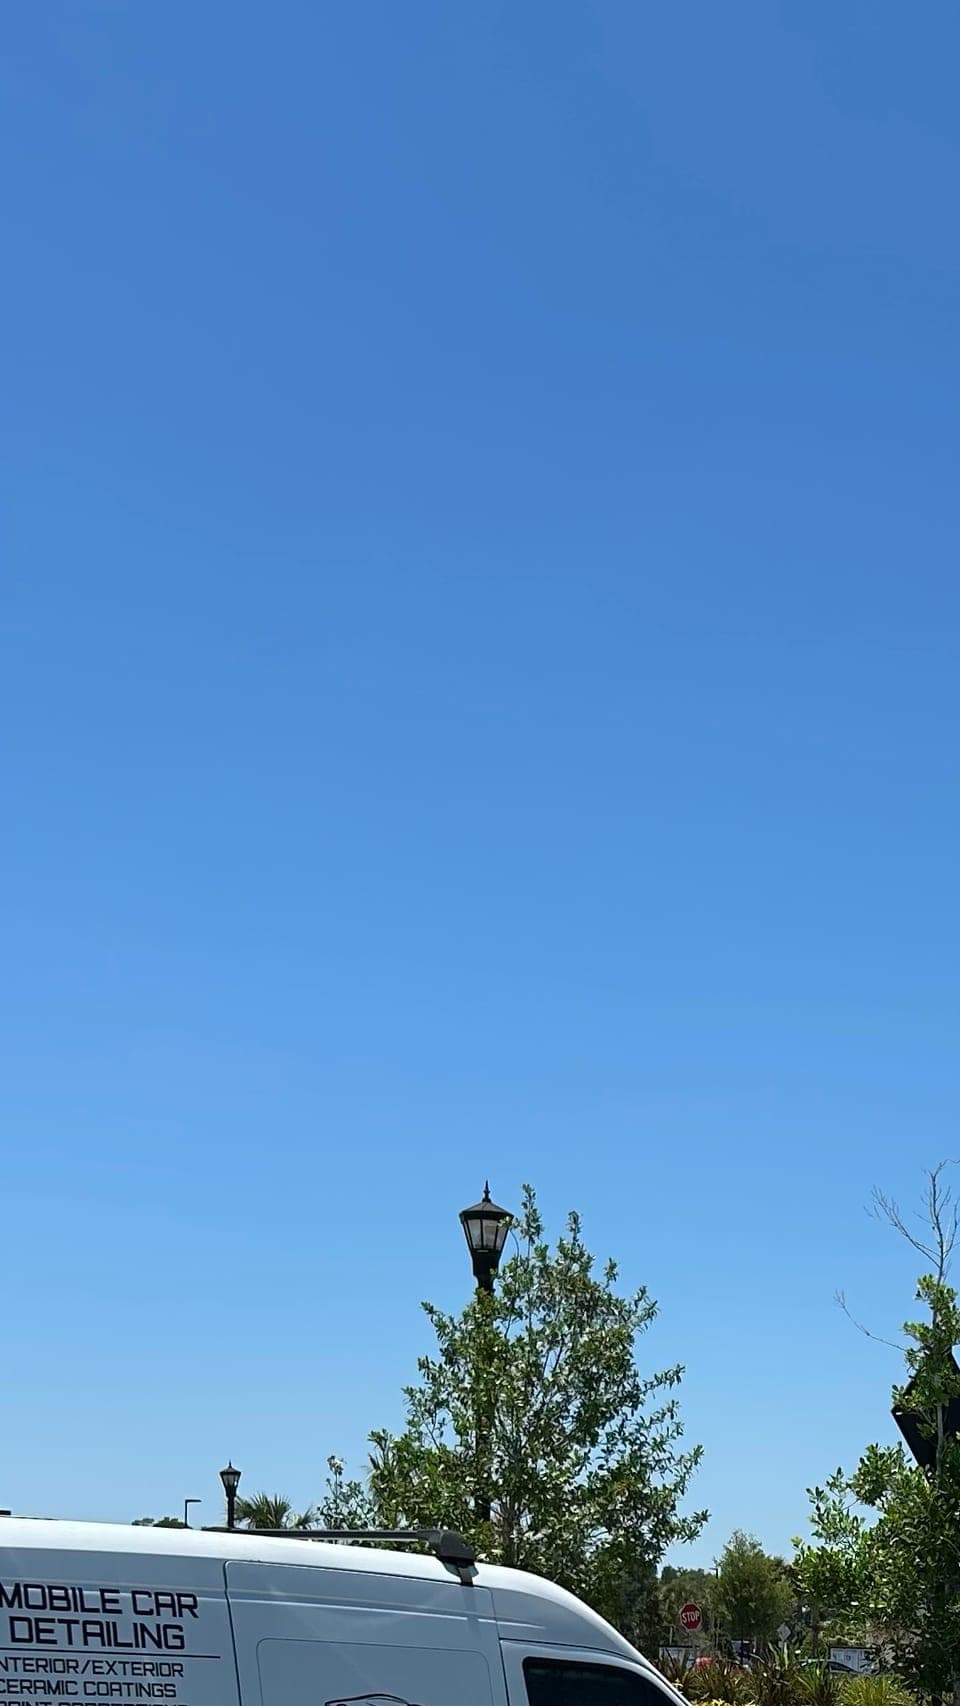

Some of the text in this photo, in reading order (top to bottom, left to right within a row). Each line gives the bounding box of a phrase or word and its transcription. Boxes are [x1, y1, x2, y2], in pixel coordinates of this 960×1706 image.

[0, 1582, 199, 1618] MOBILE CAR
[682, 1610, 700, 1623] STOP
[9, 1616, 185, 1650] DETAILING
[83, 1681, 177, 1698] COATINGS
